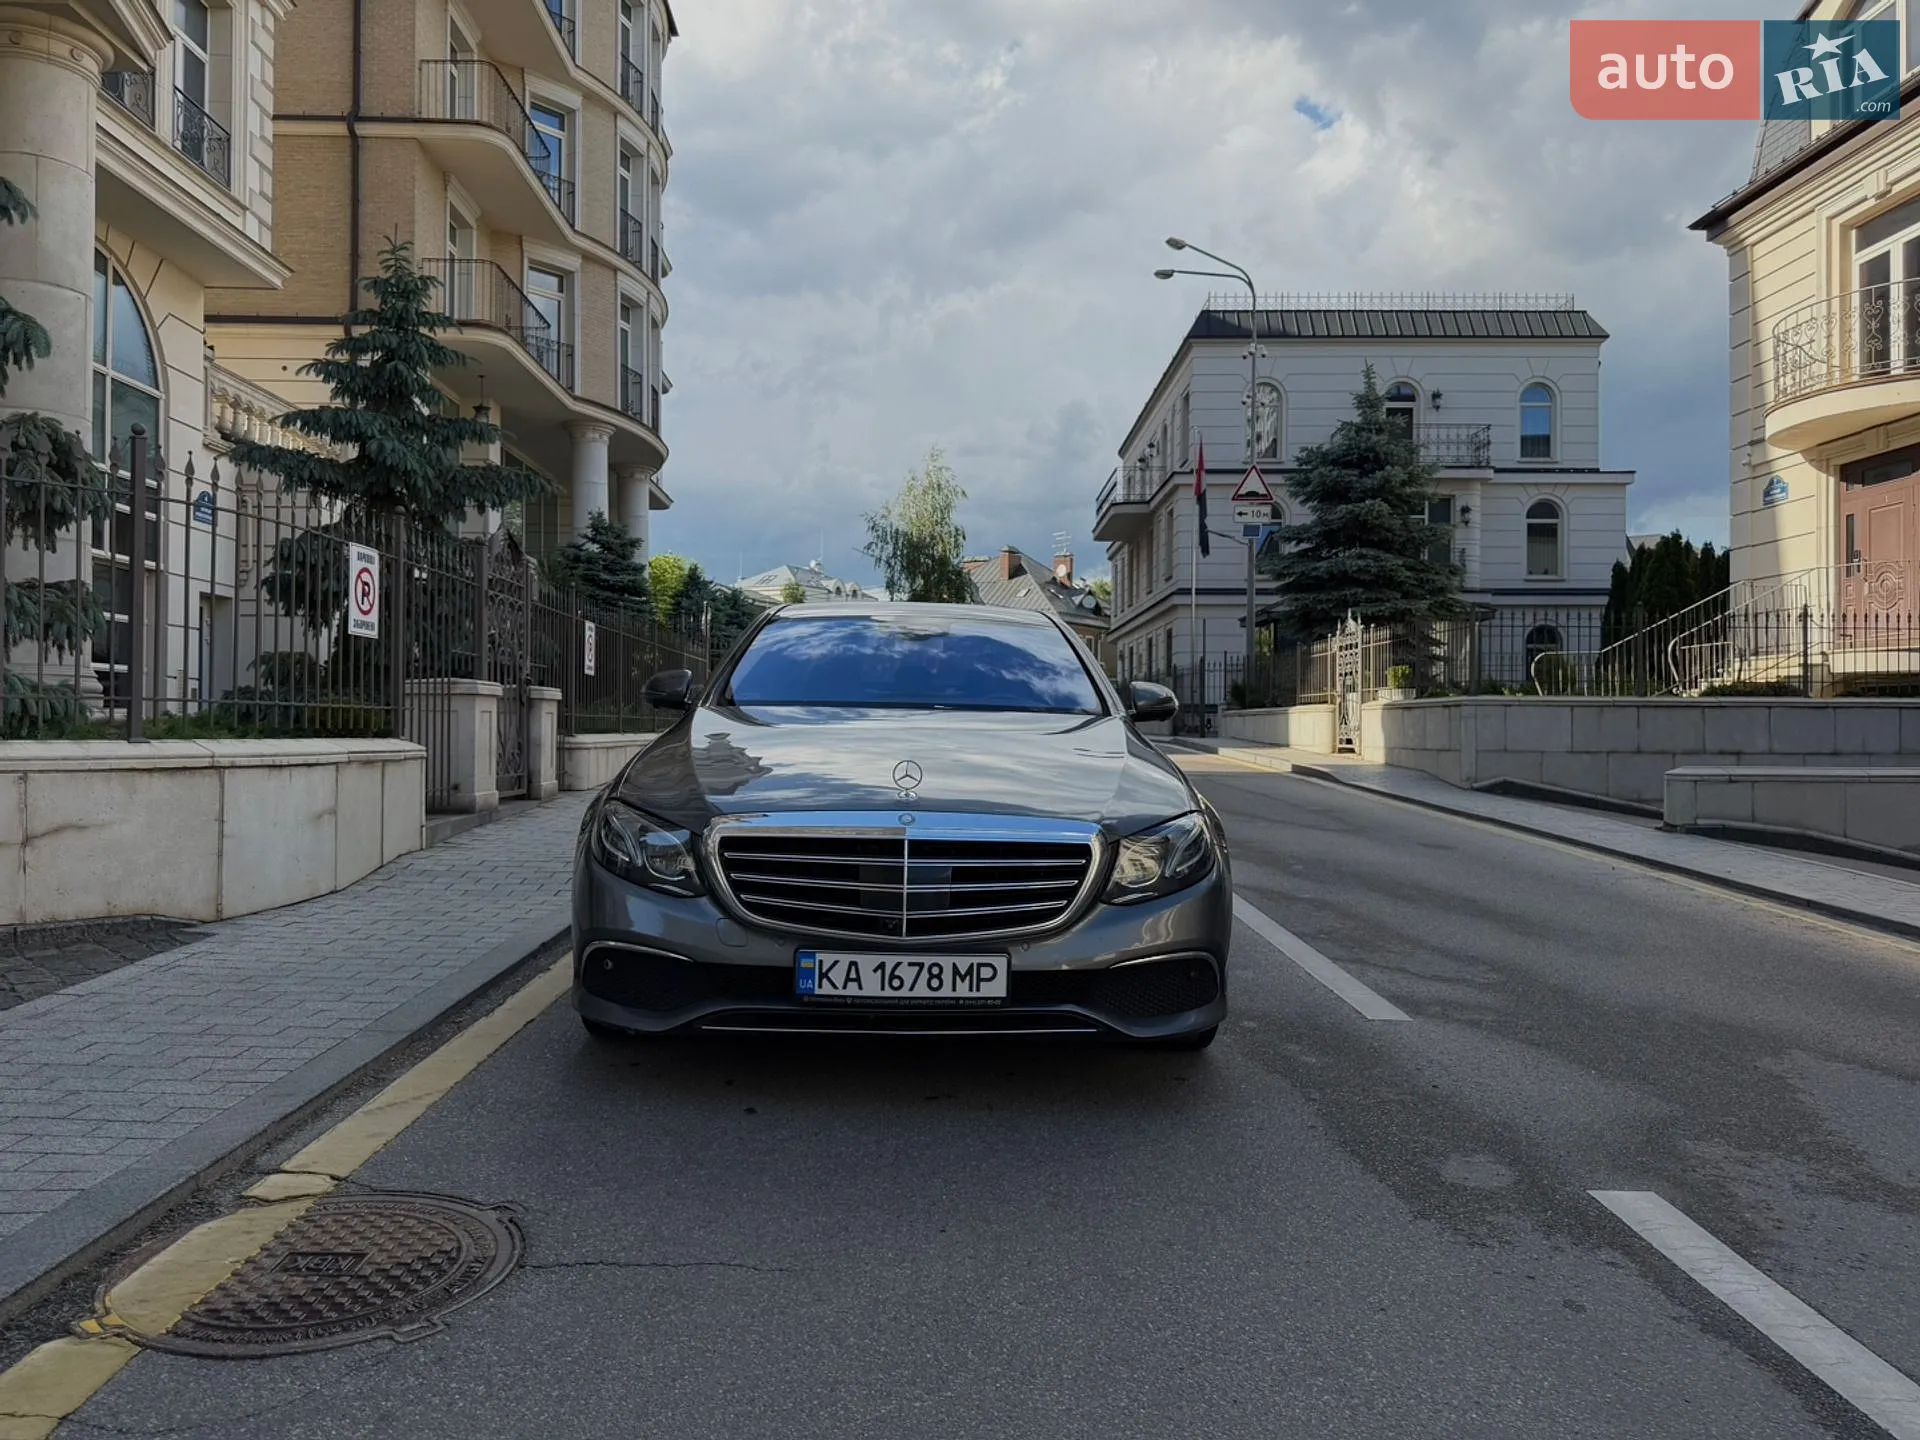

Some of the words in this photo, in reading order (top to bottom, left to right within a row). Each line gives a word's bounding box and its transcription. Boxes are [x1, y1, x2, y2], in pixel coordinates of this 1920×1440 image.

[1251, 510, 1261, 518] 10
[817, 959, 864, 991] KA
[872, 960, 944, 992] 1678
[951, 961, 998, 993] MP
[799, 979, 814, 990] UA
